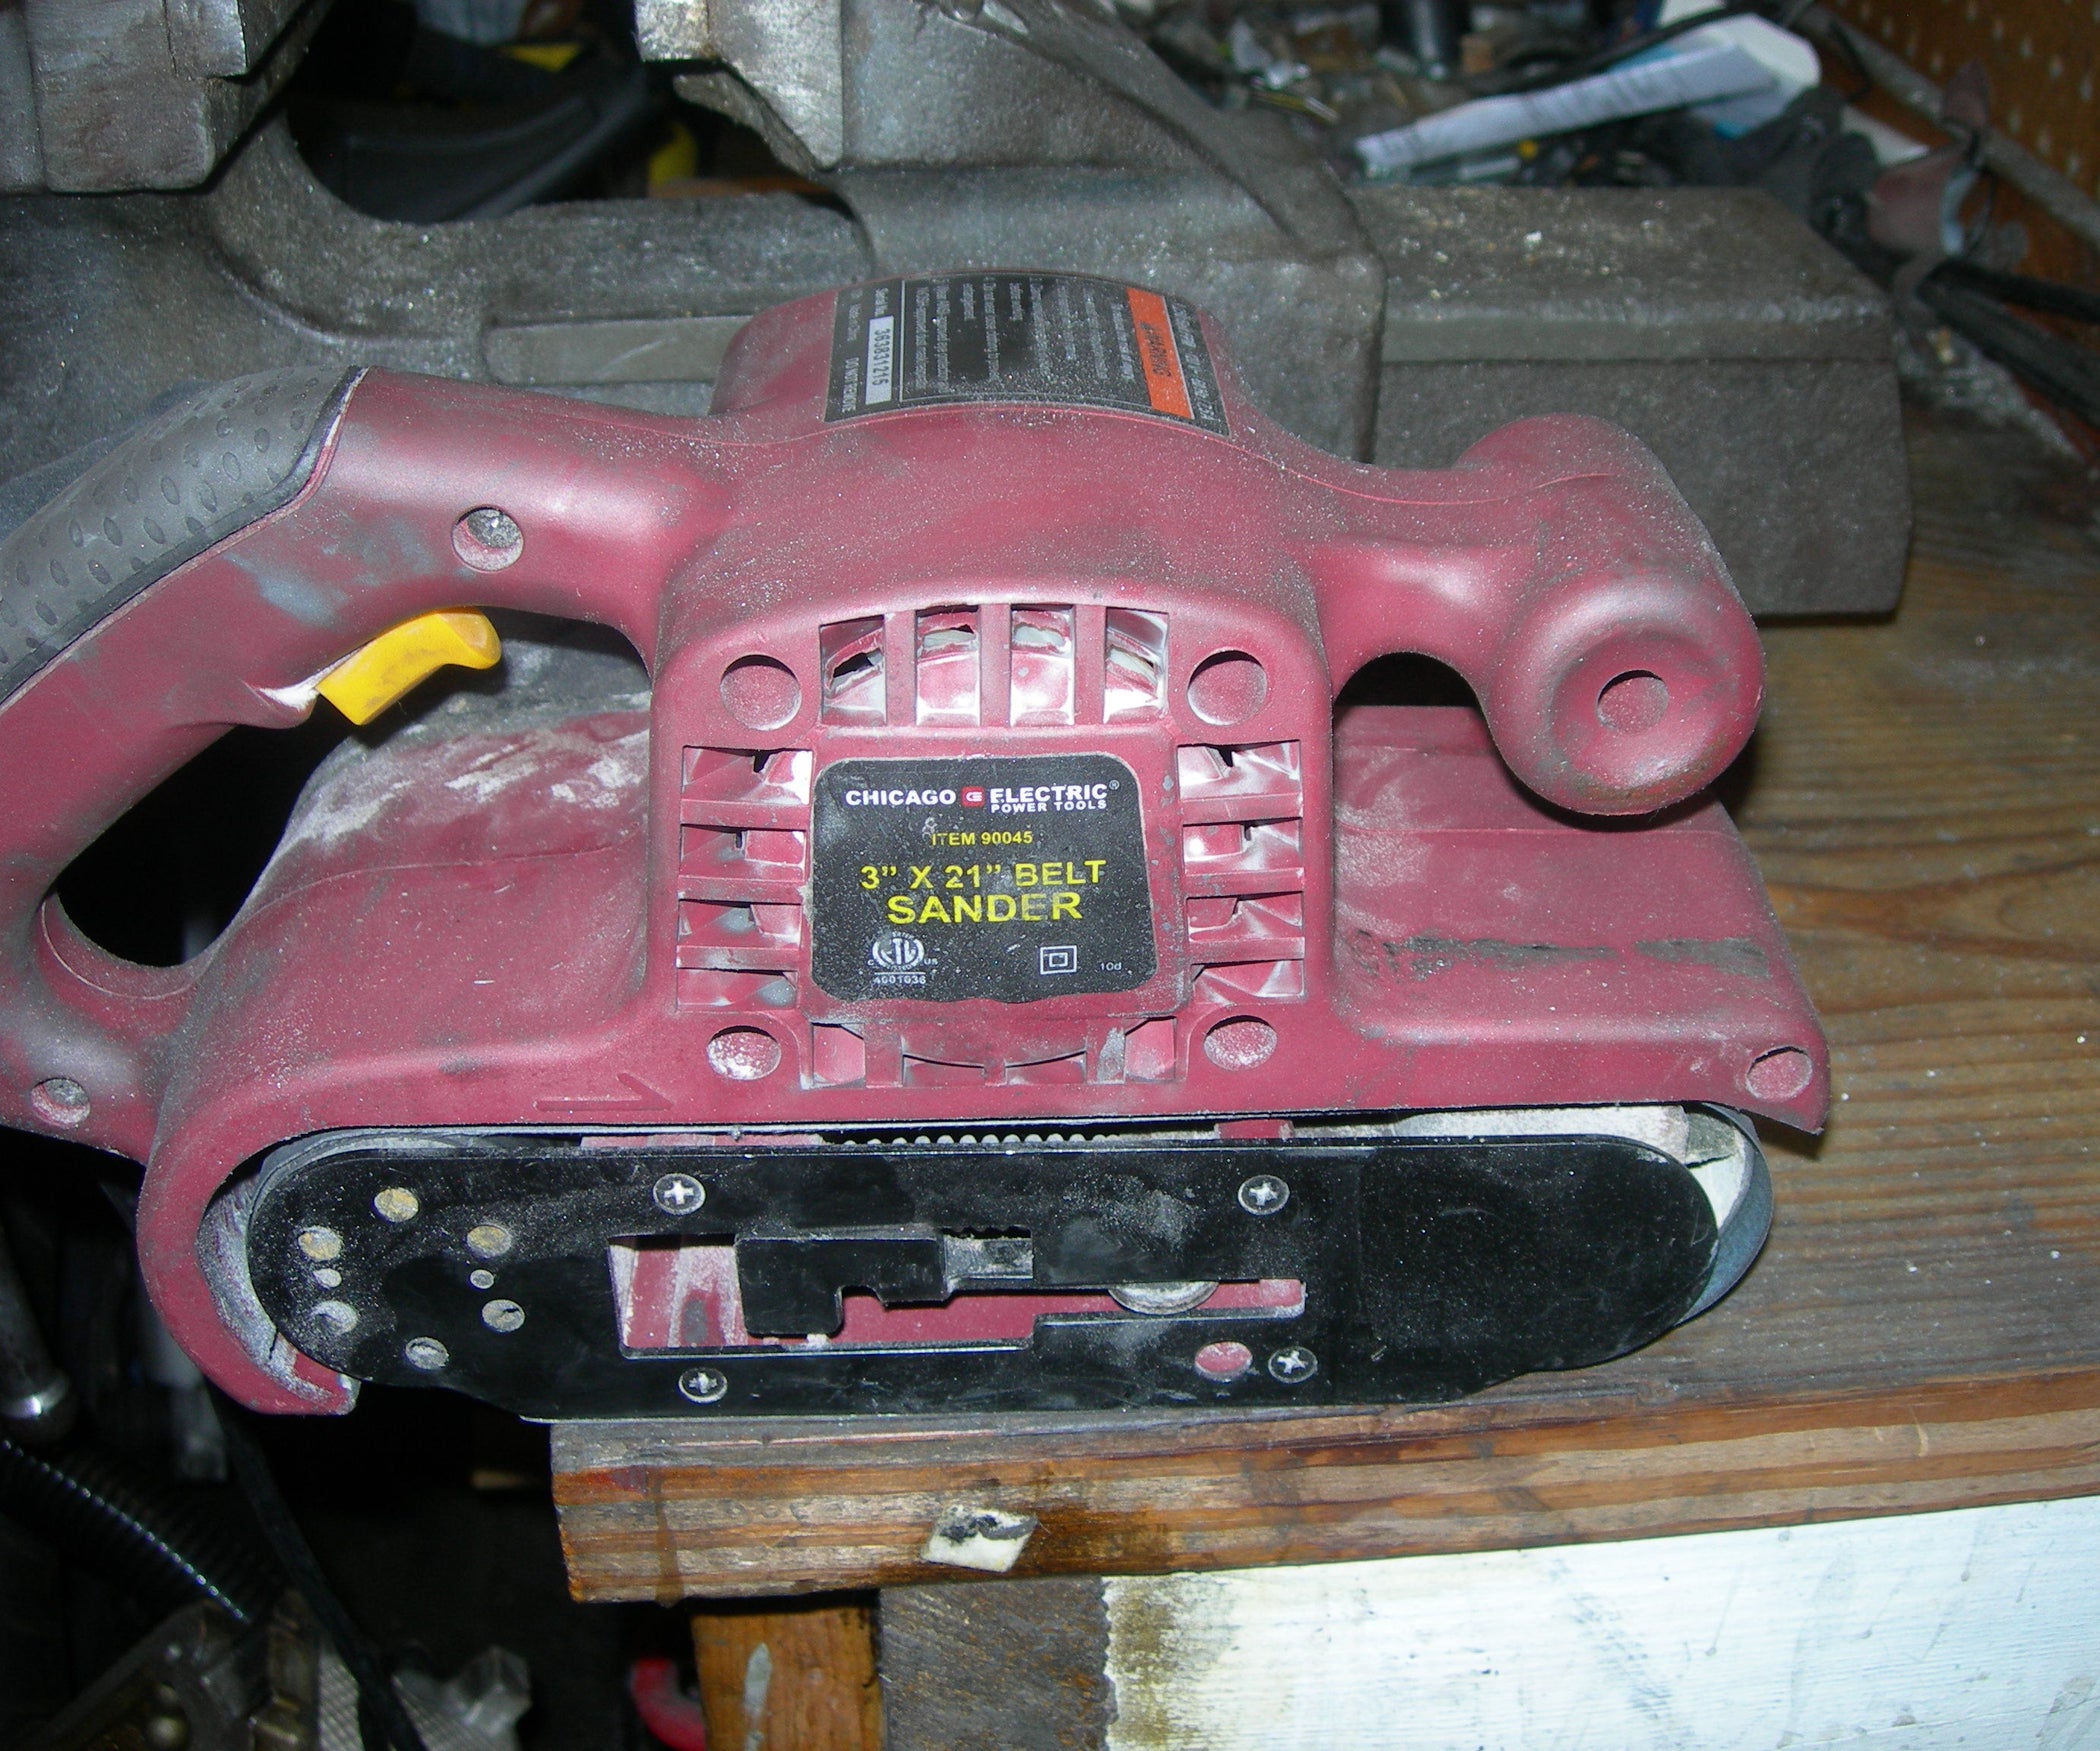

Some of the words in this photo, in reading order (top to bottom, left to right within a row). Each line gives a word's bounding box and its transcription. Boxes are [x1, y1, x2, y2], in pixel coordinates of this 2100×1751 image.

[872, 328, 891, 386] 363831215
[845, 789, 957, 806] CHICAGO
[991, 802, 1047, 814] POWER
[1053, 799, 1107, 812] TOOLS
[931, 832, 976, 846] ITEM
[981, 830, 1033, 845] 90045
[1014, 860, 1107, 887] BELT
[887, 891, 1083, 924] SANDER
